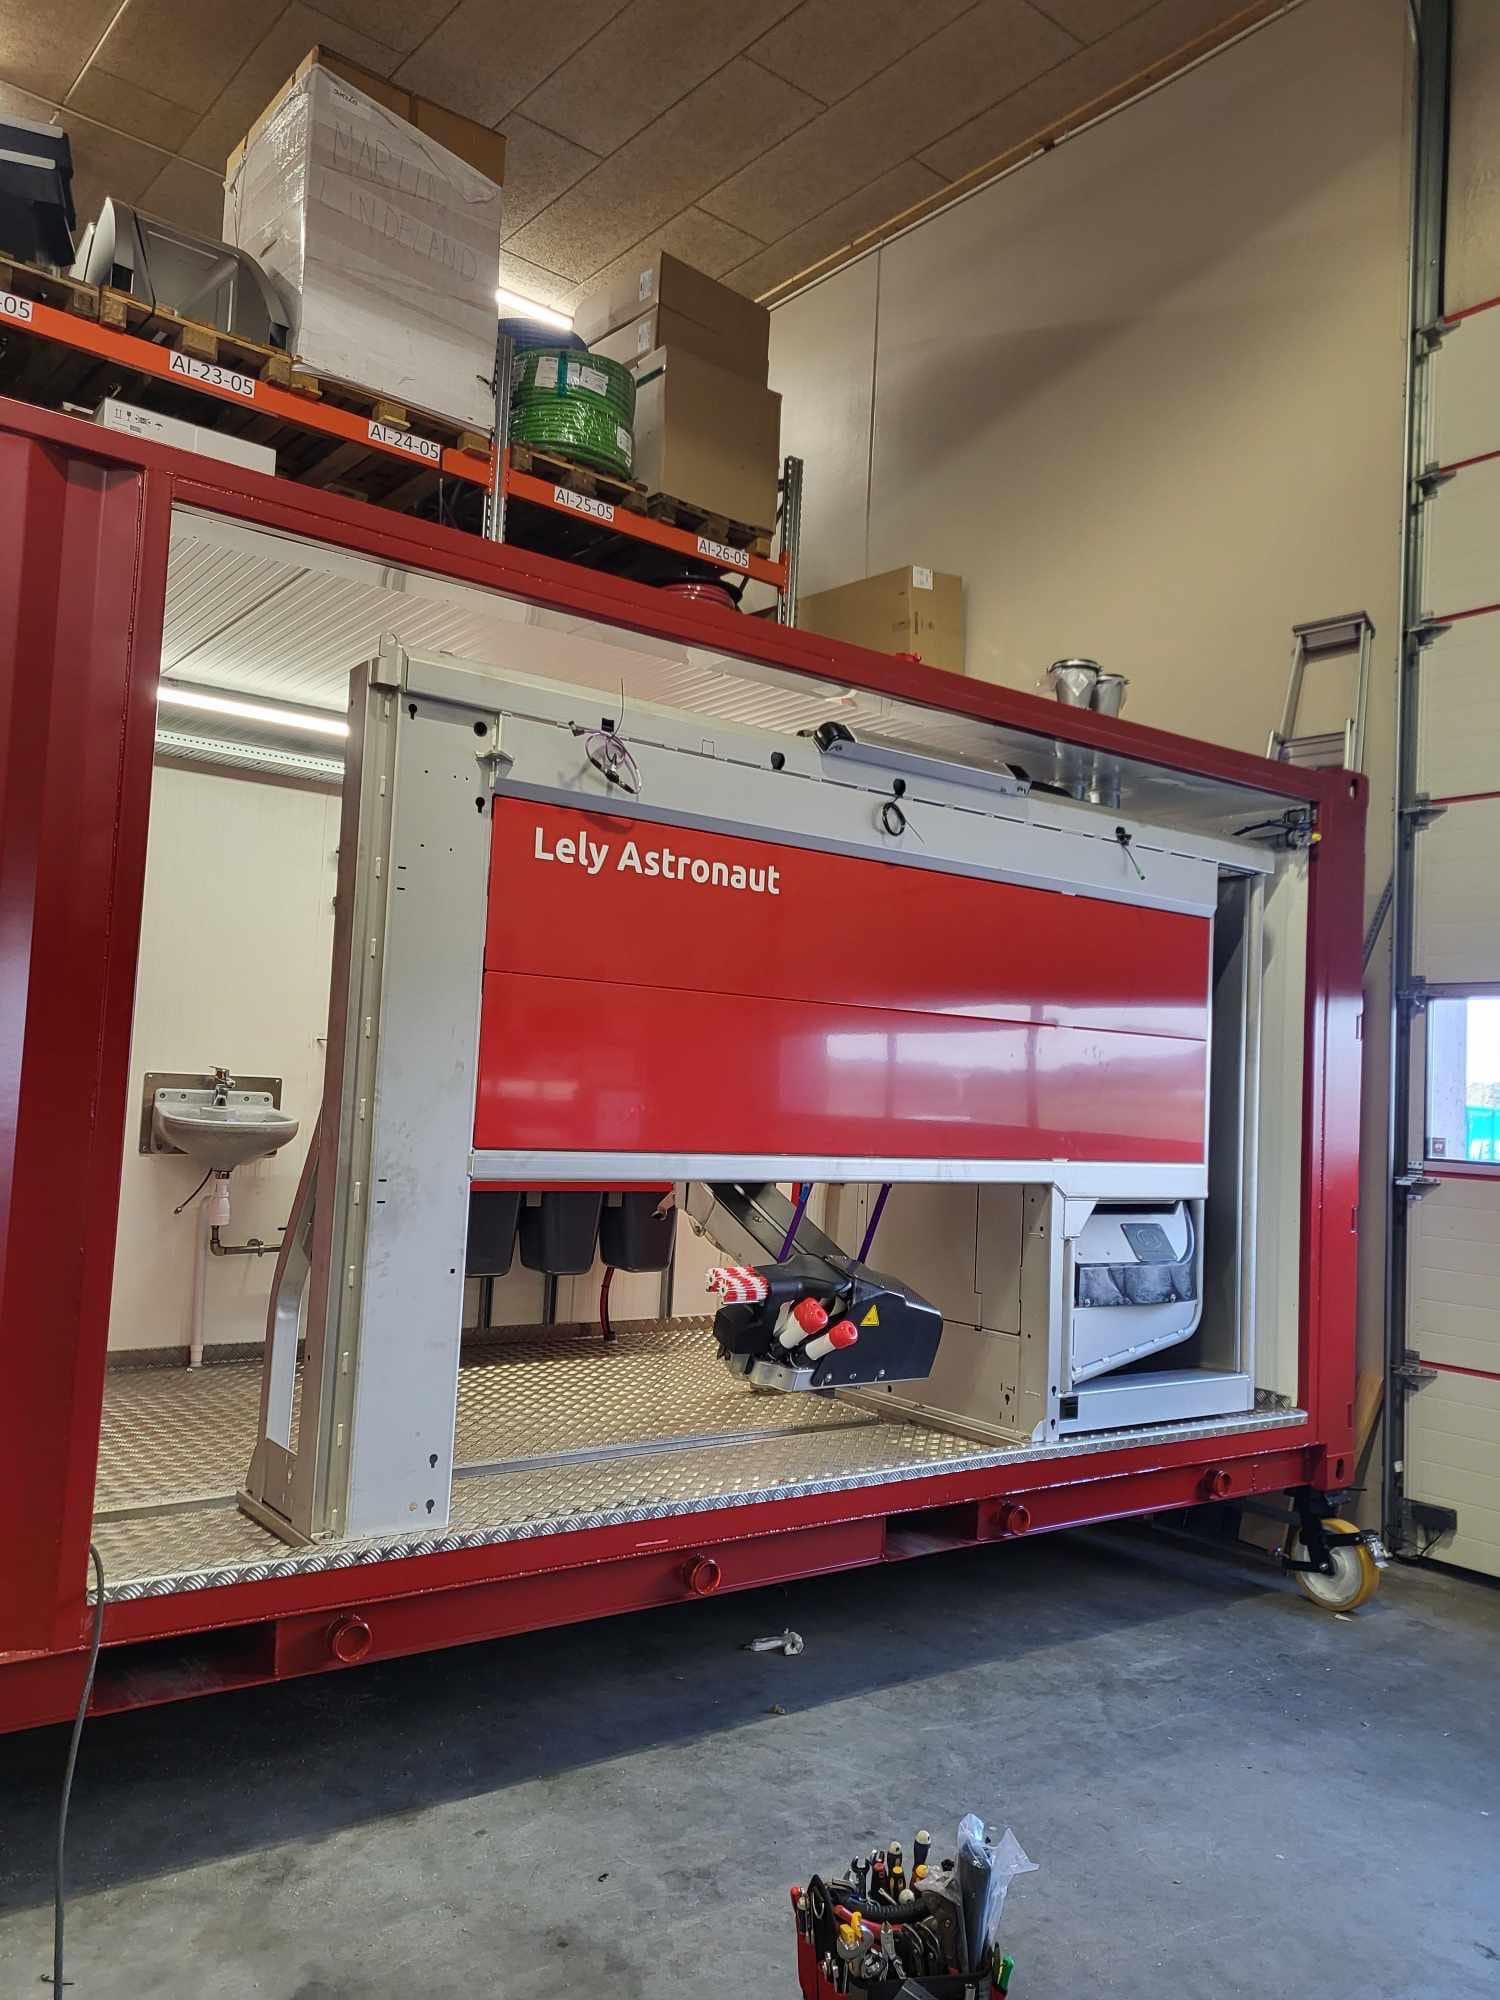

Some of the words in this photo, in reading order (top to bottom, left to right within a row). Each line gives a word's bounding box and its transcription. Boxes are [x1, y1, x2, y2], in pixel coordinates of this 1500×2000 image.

[172, 355, 253, 395] AI-23-05
[370, 424, 438, 459] AI-24-05
[556, 489, 613, 520] AI-25-05
[700, 540, 748, 567] AI-26-05
[534, 826, 609, 875] Lely
[617, 841, 780, 895] Astronaut
